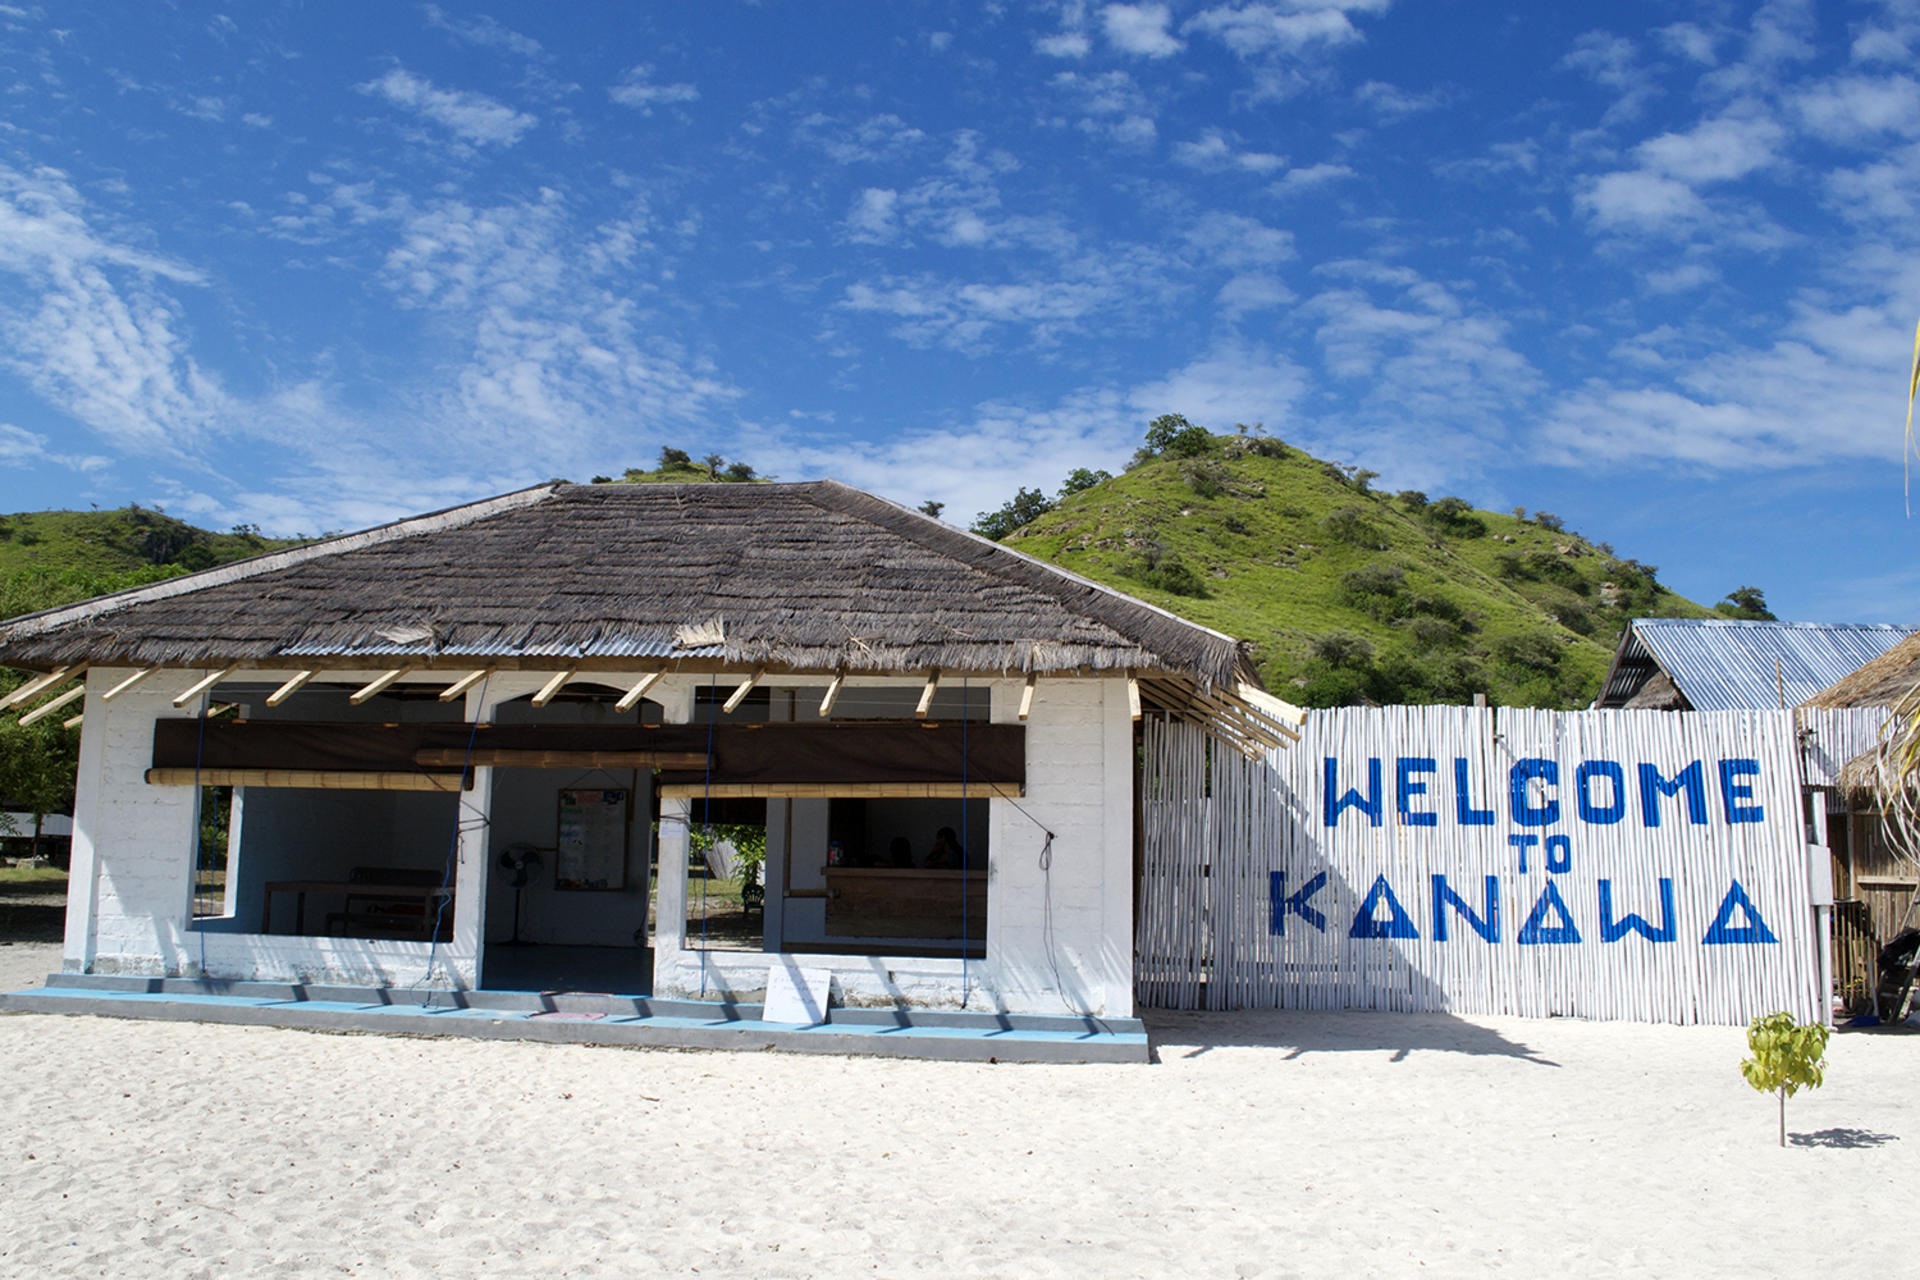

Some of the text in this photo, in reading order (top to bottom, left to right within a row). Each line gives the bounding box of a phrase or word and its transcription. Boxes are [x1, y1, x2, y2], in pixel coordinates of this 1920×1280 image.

[1324, 757, 1764, 828] WELCOME
[1508, 834, 1572, 874] TO
[1270, 871, 1779, 945] KANAWA
